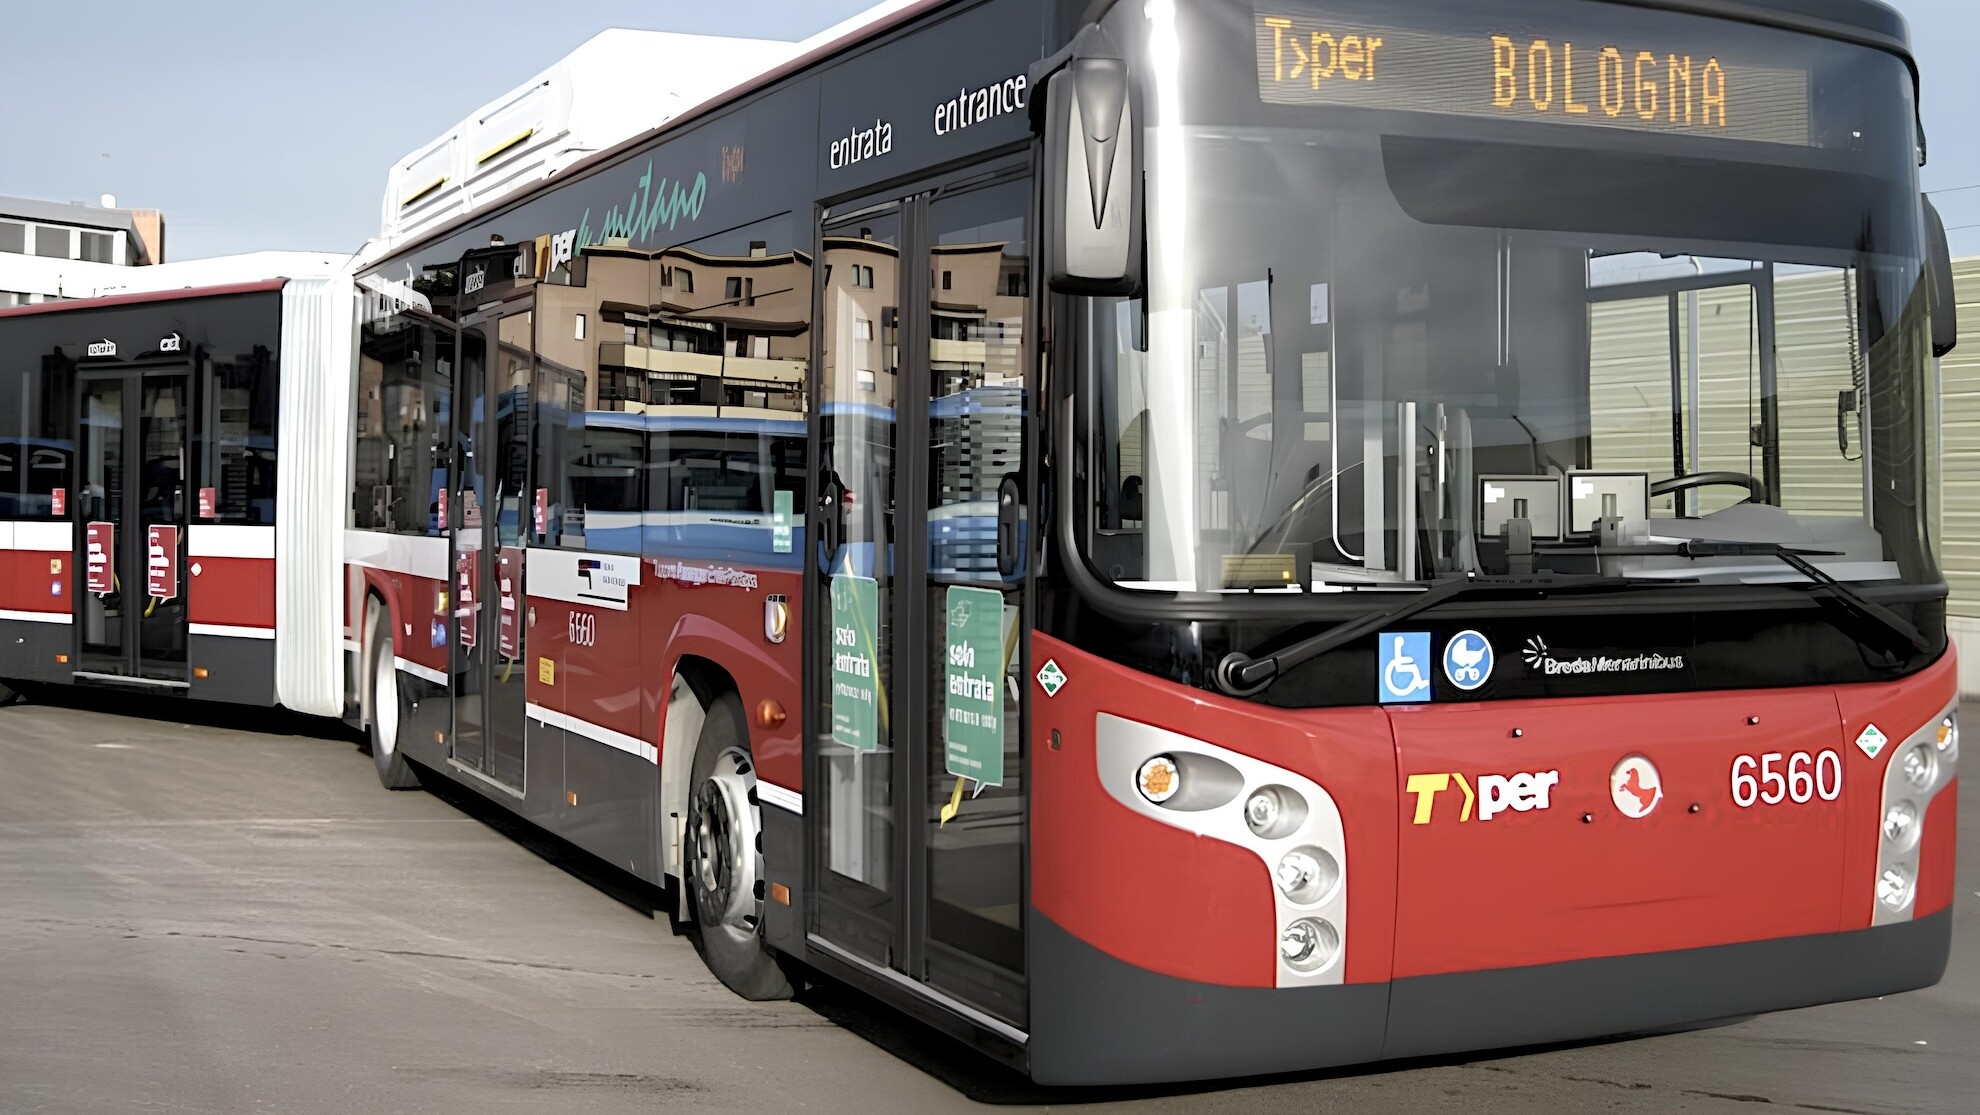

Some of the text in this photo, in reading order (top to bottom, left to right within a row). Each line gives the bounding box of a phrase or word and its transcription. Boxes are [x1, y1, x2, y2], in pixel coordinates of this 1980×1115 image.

[1490, 35, 1727, 127] BOLOGNA
[829, 74, 1027, 170] entrata entrance
[949, 670, 994, 702] entrata
[1731, 749, 1842, 807] 6560
